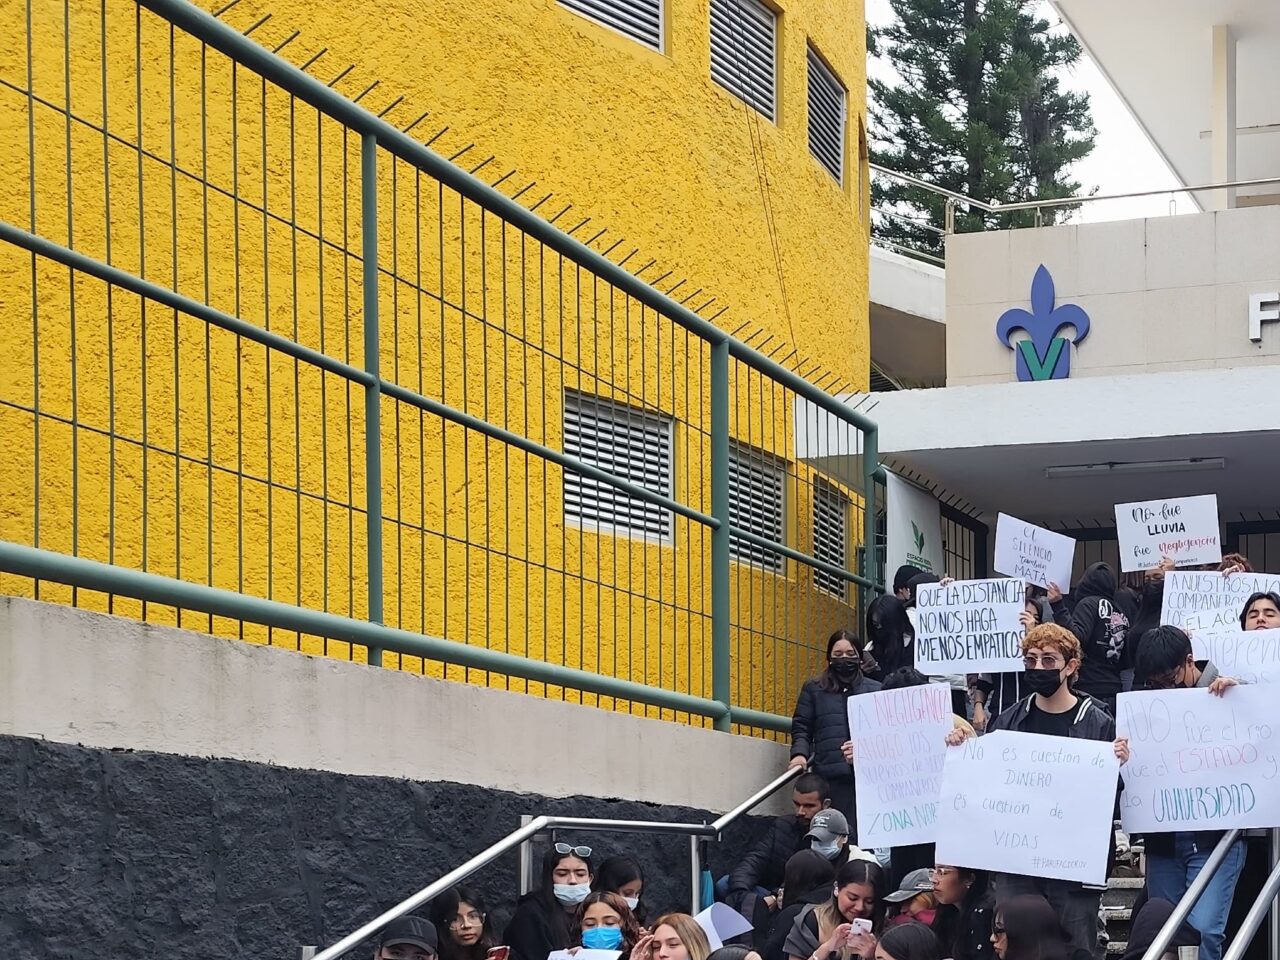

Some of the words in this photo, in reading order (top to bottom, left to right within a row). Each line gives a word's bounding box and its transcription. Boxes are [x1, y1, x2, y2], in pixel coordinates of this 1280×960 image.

[1147, 522, 1186, 536] LLUVIA
[1015, 564, 1049, 586] MATA
[918, 588, 945, 607] QUE
[946, 586, 960, 605] LA
[962, 580, 1027, 605] DISTANCIA
[919, 612, 937, 634] NO
[939, 610, 964, 634] NOS
[966, 607, 998, 632] HAGA
[917, 634, 966, 662] MENOS
[1183, 710, 1213, 744] fue
[963, 738, 984, 761] No
[1002, 747, 1018, 760] es
[1092, 750, 1106, 770] de
[1262, 753, 1278, 780] y
[1005, 768, 1053, 788] DINERO
[954, 793, 968, 812] es
[1051, 804, 1064, 821] de
[1153, 782, 1256, 823] UNIVERSIDAD
[994, 829, 1040, 851] VIDAS
